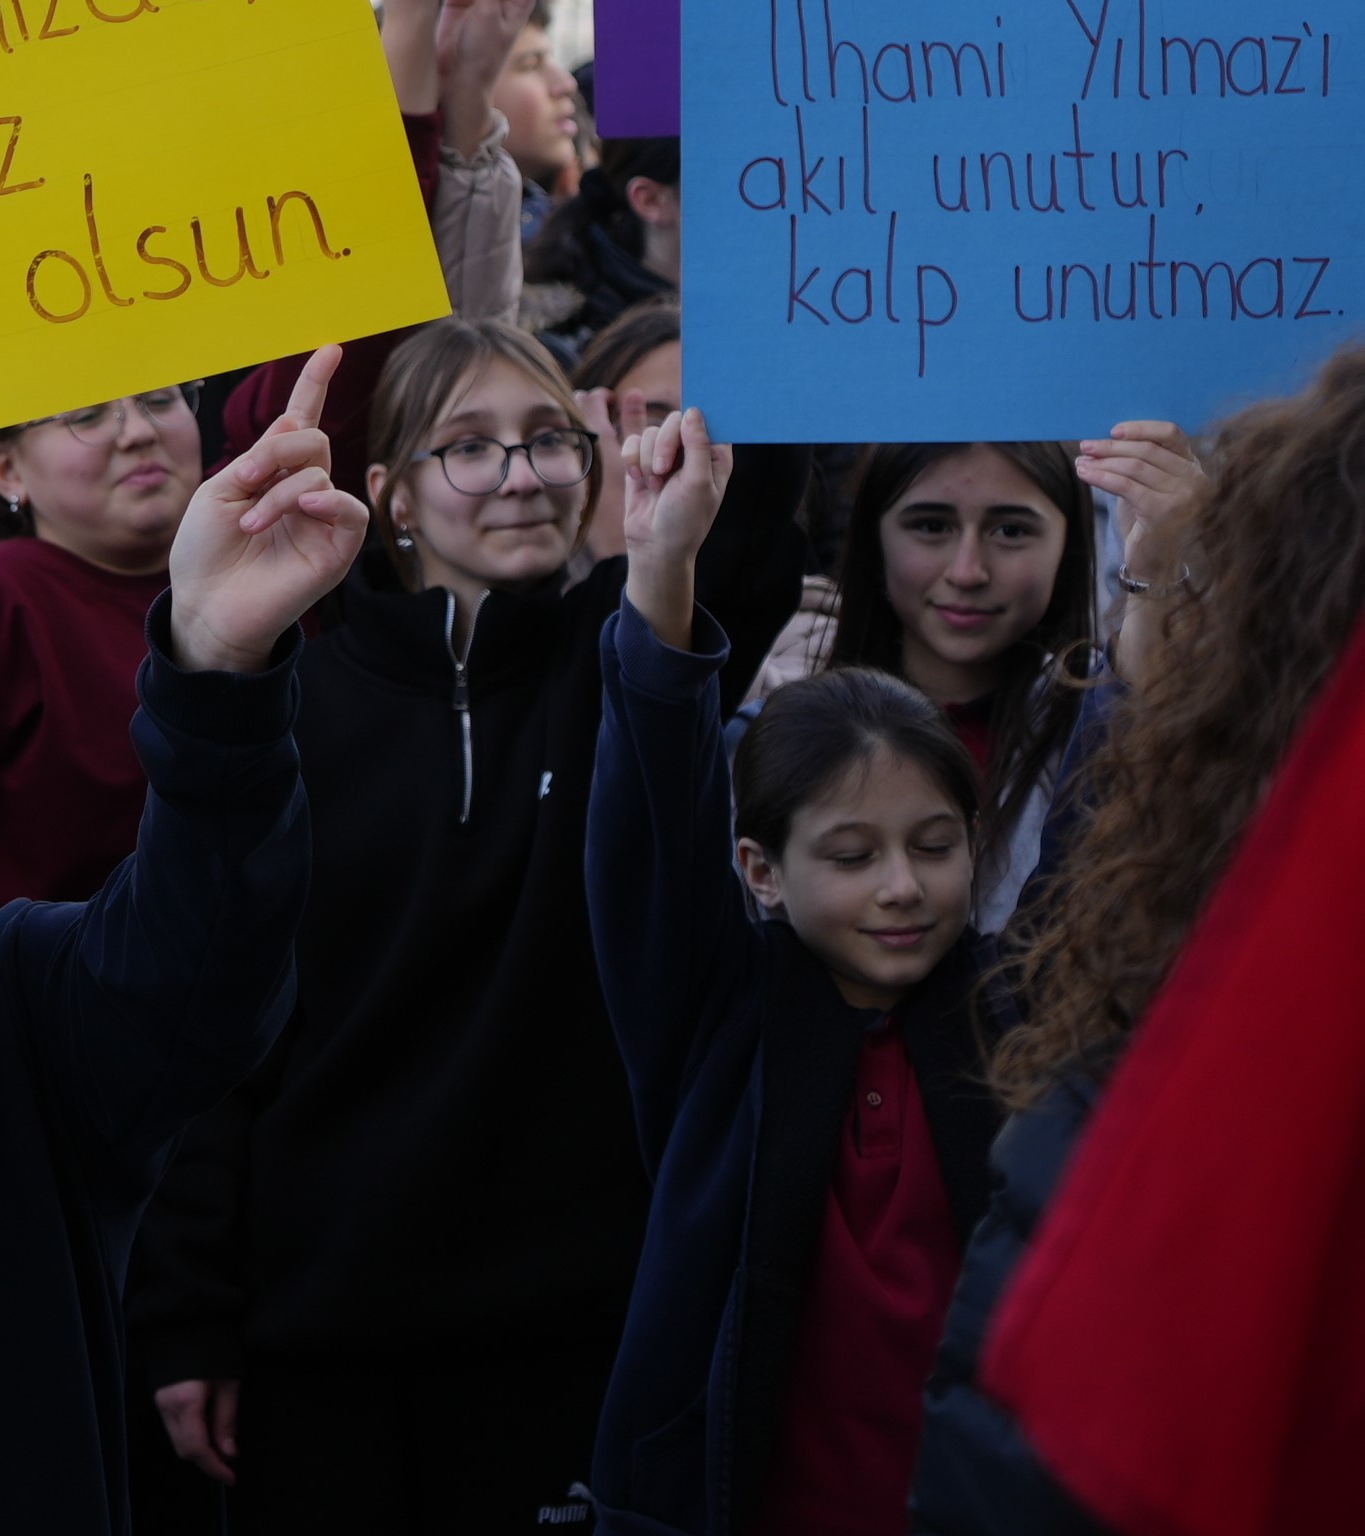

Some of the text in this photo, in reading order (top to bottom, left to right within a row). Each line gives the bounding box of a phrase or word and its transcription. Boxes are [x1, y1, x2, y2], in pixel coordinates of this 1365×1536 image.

[737, 102, 1204, 216] akıl unutur,
[25, 172, 353, 325] olsun.
[787, 210, 1345, 378] kalp unutmaz.
[537, 1504, 589, 1524] PUMA
